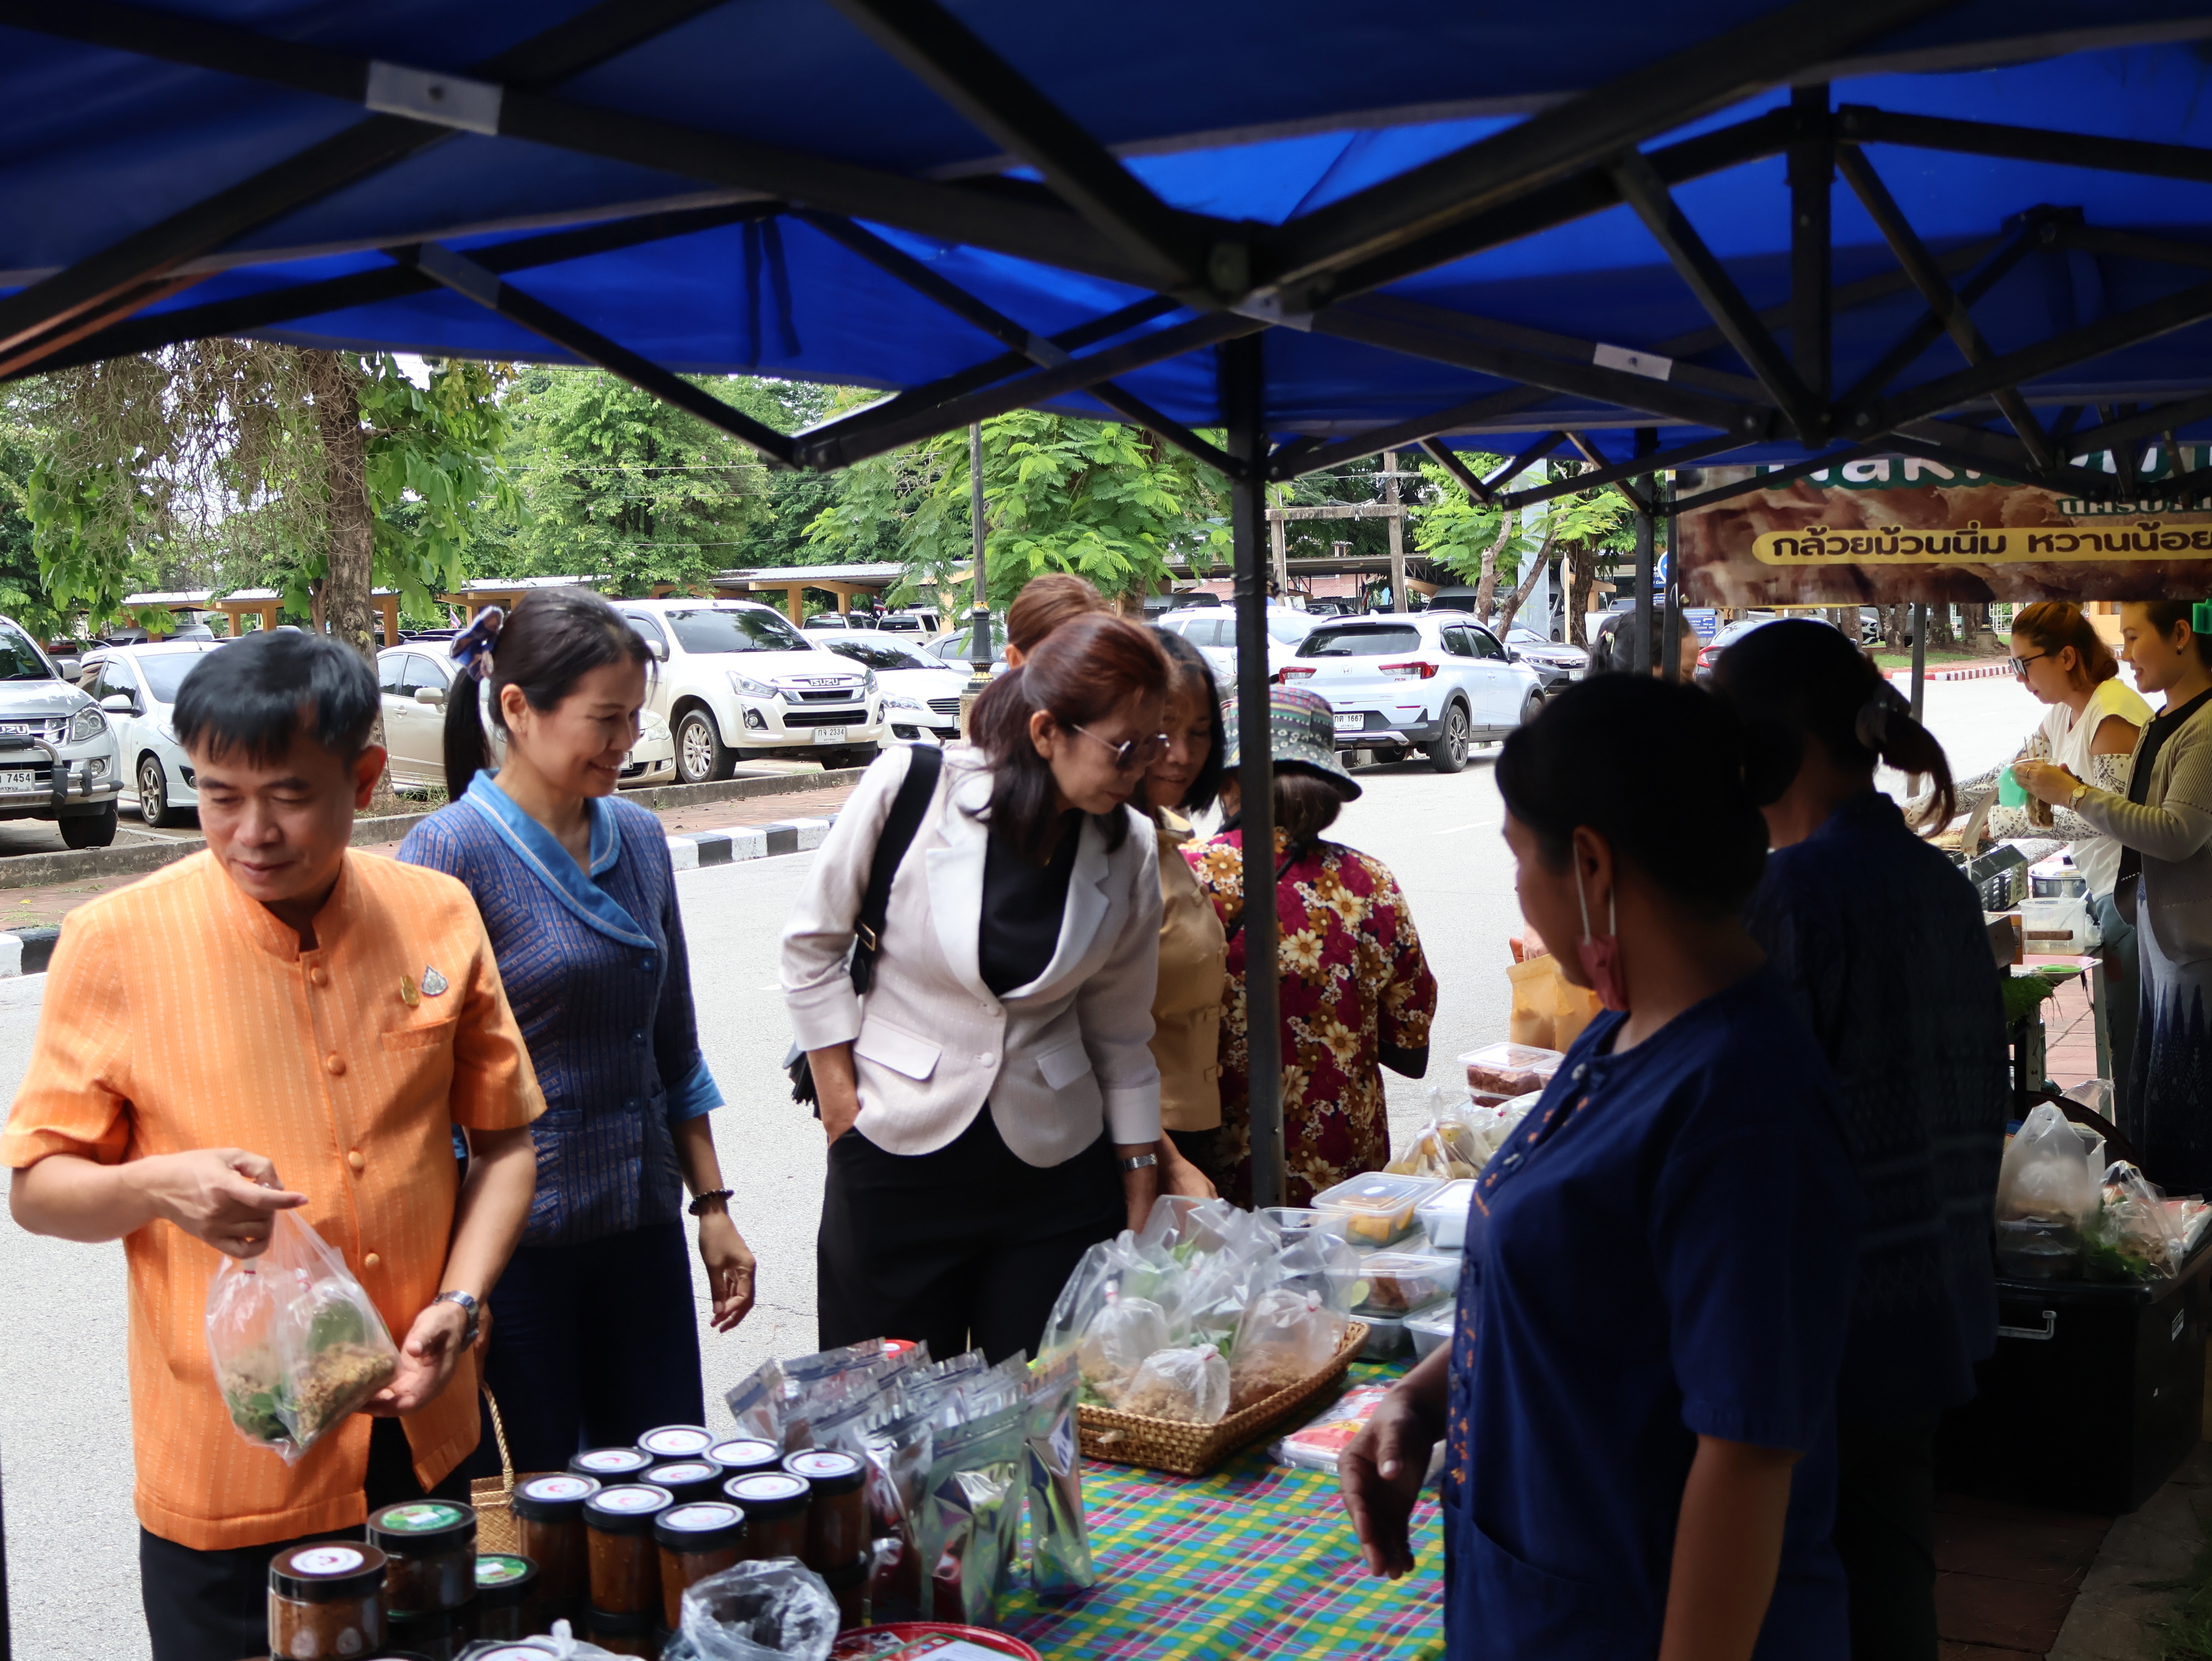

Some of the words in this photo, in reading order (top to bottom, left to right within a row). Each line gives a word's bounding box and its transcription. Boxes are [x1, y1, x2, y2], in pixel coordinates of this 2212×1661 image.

[1772, 522, 2007, 556] กล้วยม้วนนิ่ม
[7, 773, 31, 783] 7454
